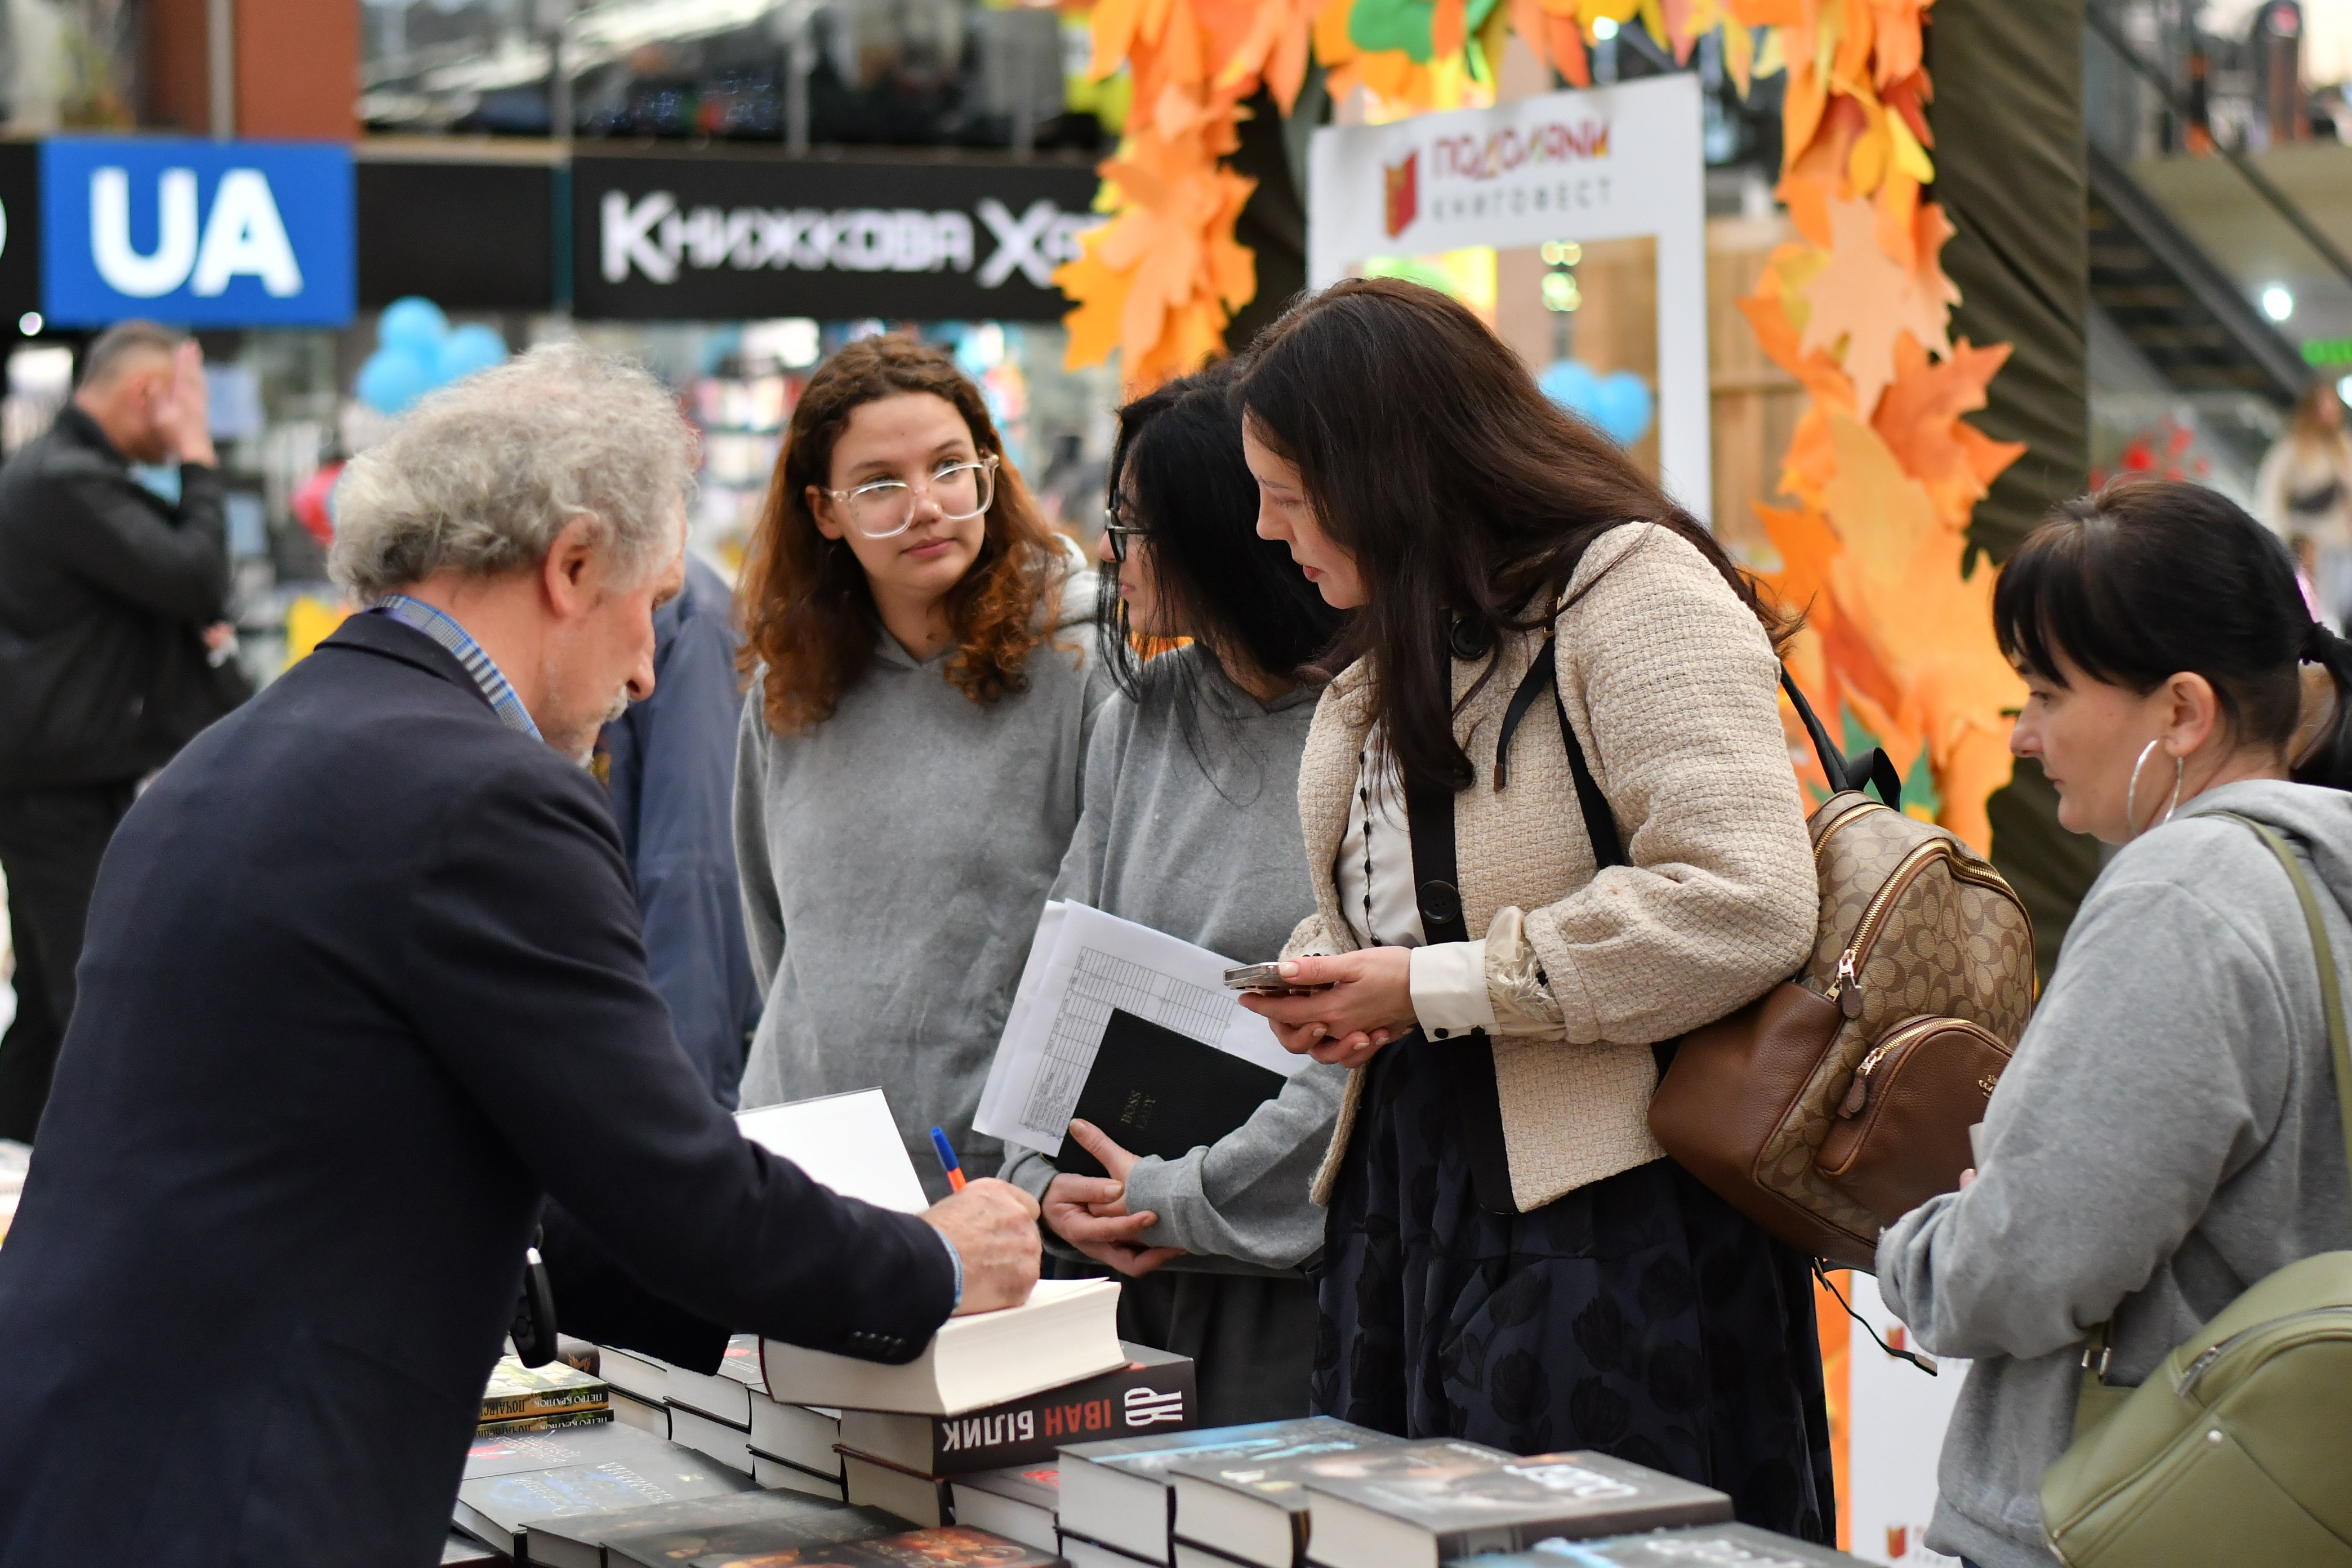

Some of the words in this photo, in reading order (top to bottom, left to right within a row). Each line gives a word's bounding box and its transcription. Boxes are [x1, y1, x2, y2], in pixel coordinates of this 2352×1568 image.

[89, 166, 304, 297] UA
[535, 1396, 572, 1408] КРАЛЮК
[574, 1393, 602, 1404] ПЕТРО
[1045, 1398, 1112, 1437] ІВАН
[942, 1410, 1034, 1451] БІЛИК
